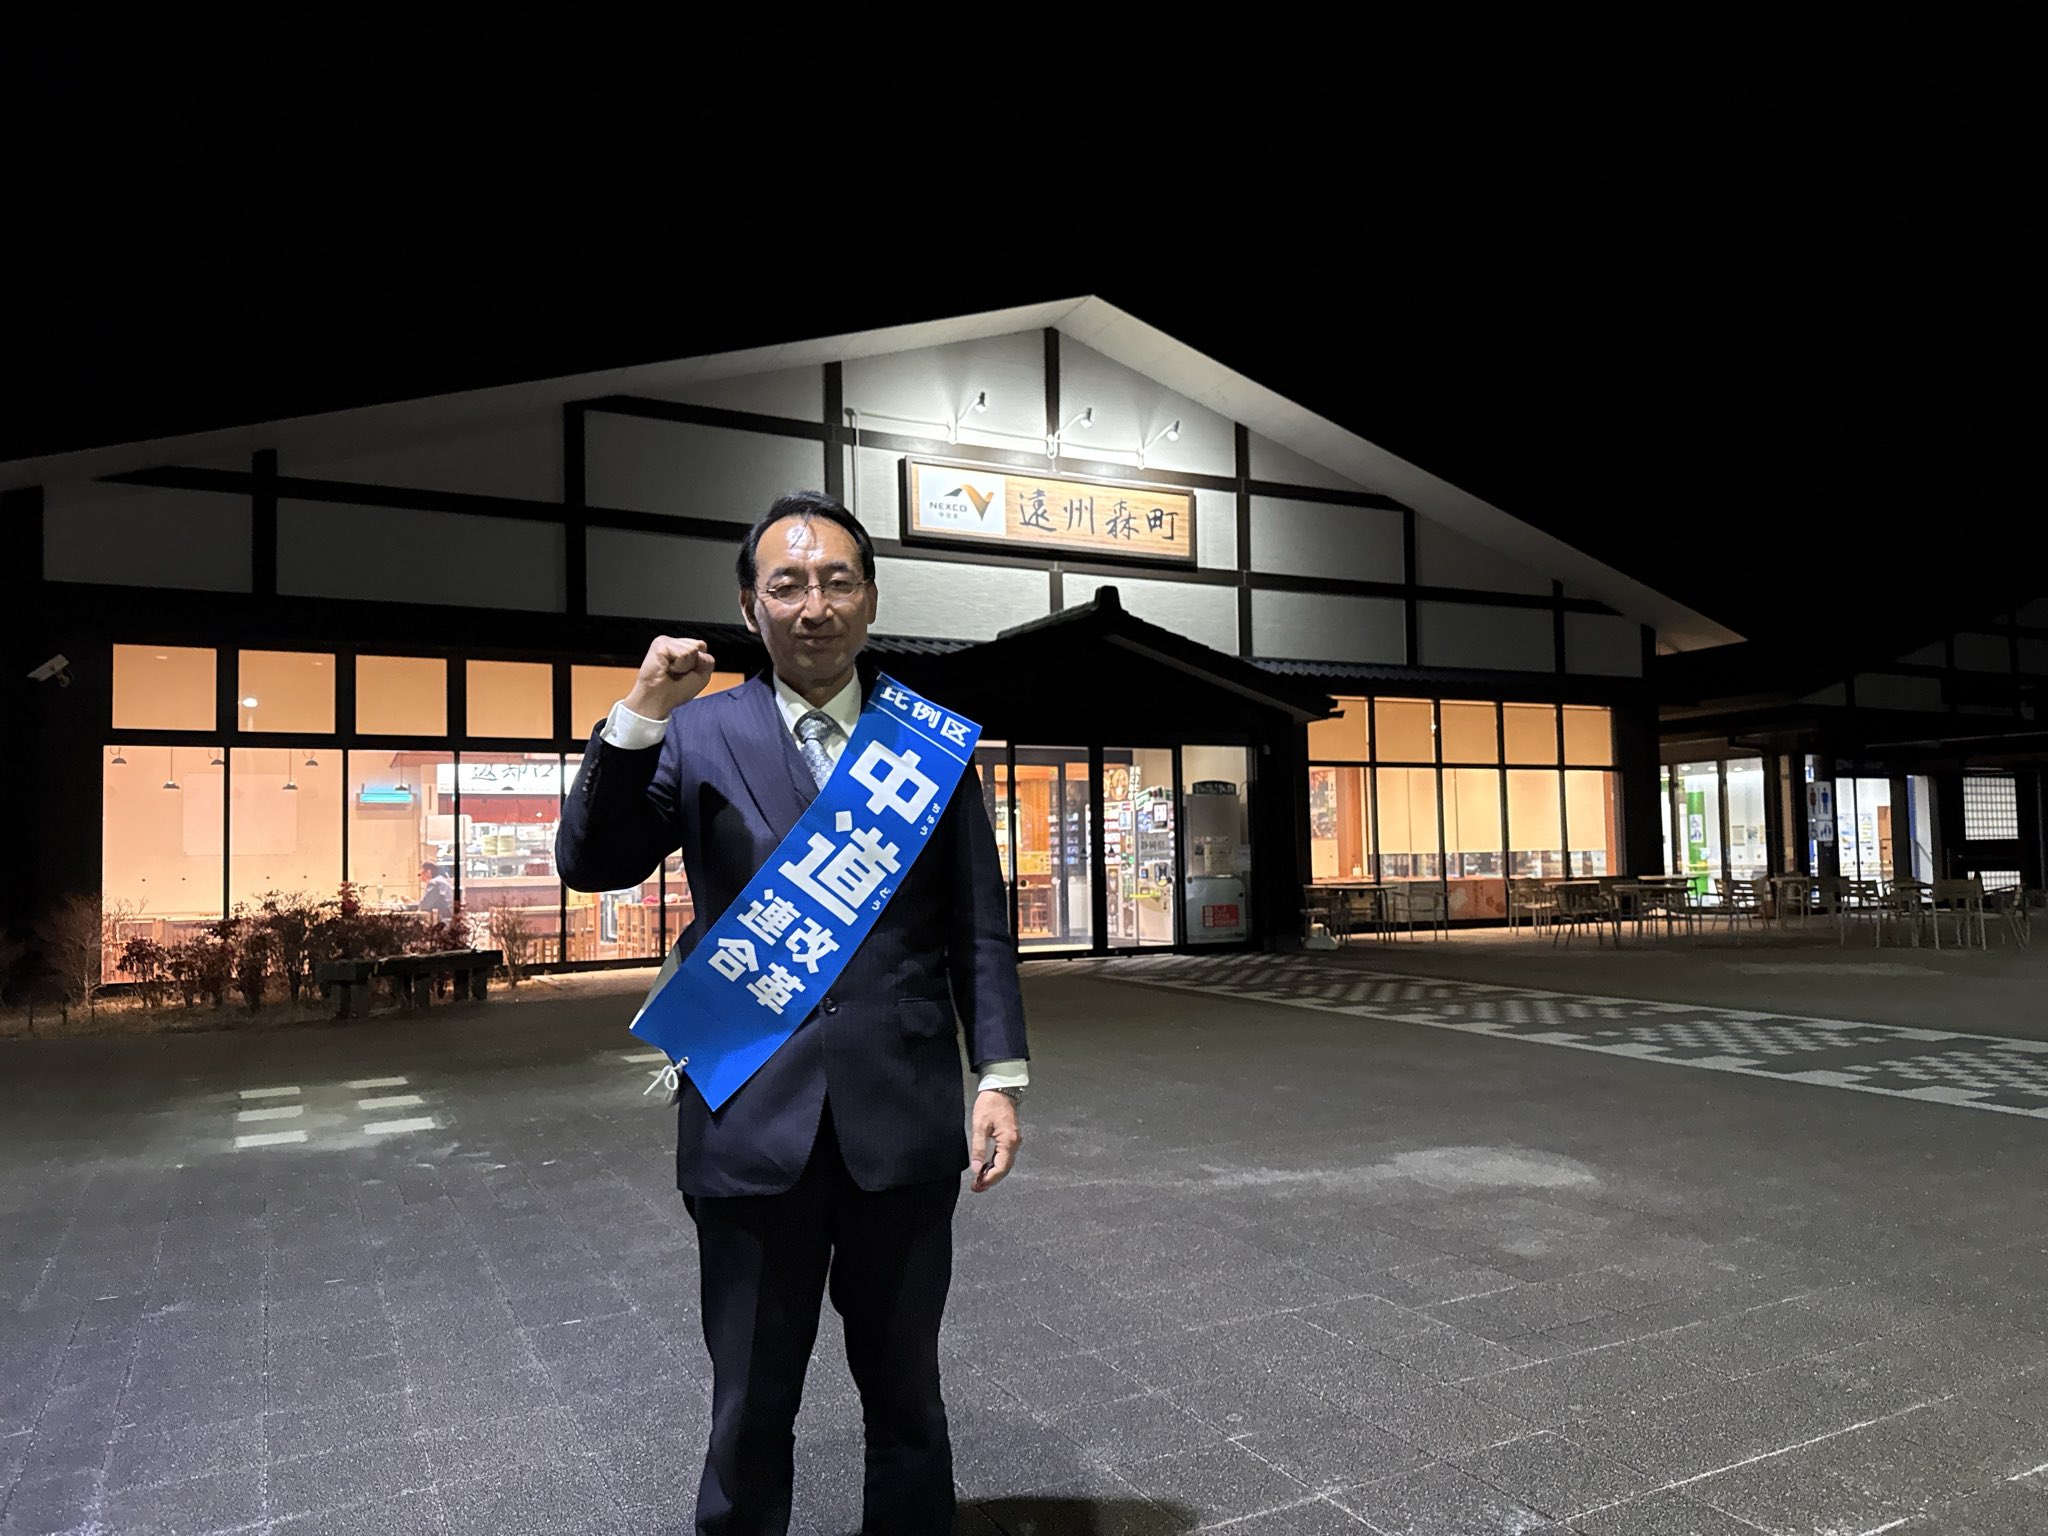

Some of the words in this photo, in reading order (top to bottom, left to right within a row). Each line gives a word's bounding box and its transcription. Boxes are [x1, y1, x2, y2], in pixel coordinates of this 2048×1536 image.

[929, 501, 968, 513] NEXCO
[1018, 487, 1180, 541] 遠州森町
[879, 686, 972, 748] 比例区
[778, 739, 940, 926] 中道
[919, 802, 942, 836] ちゅう
[871, 887, 892, 911] どう
[707, 888, 794, 983] 連合
[745, 917, 840, 1015] 改革
